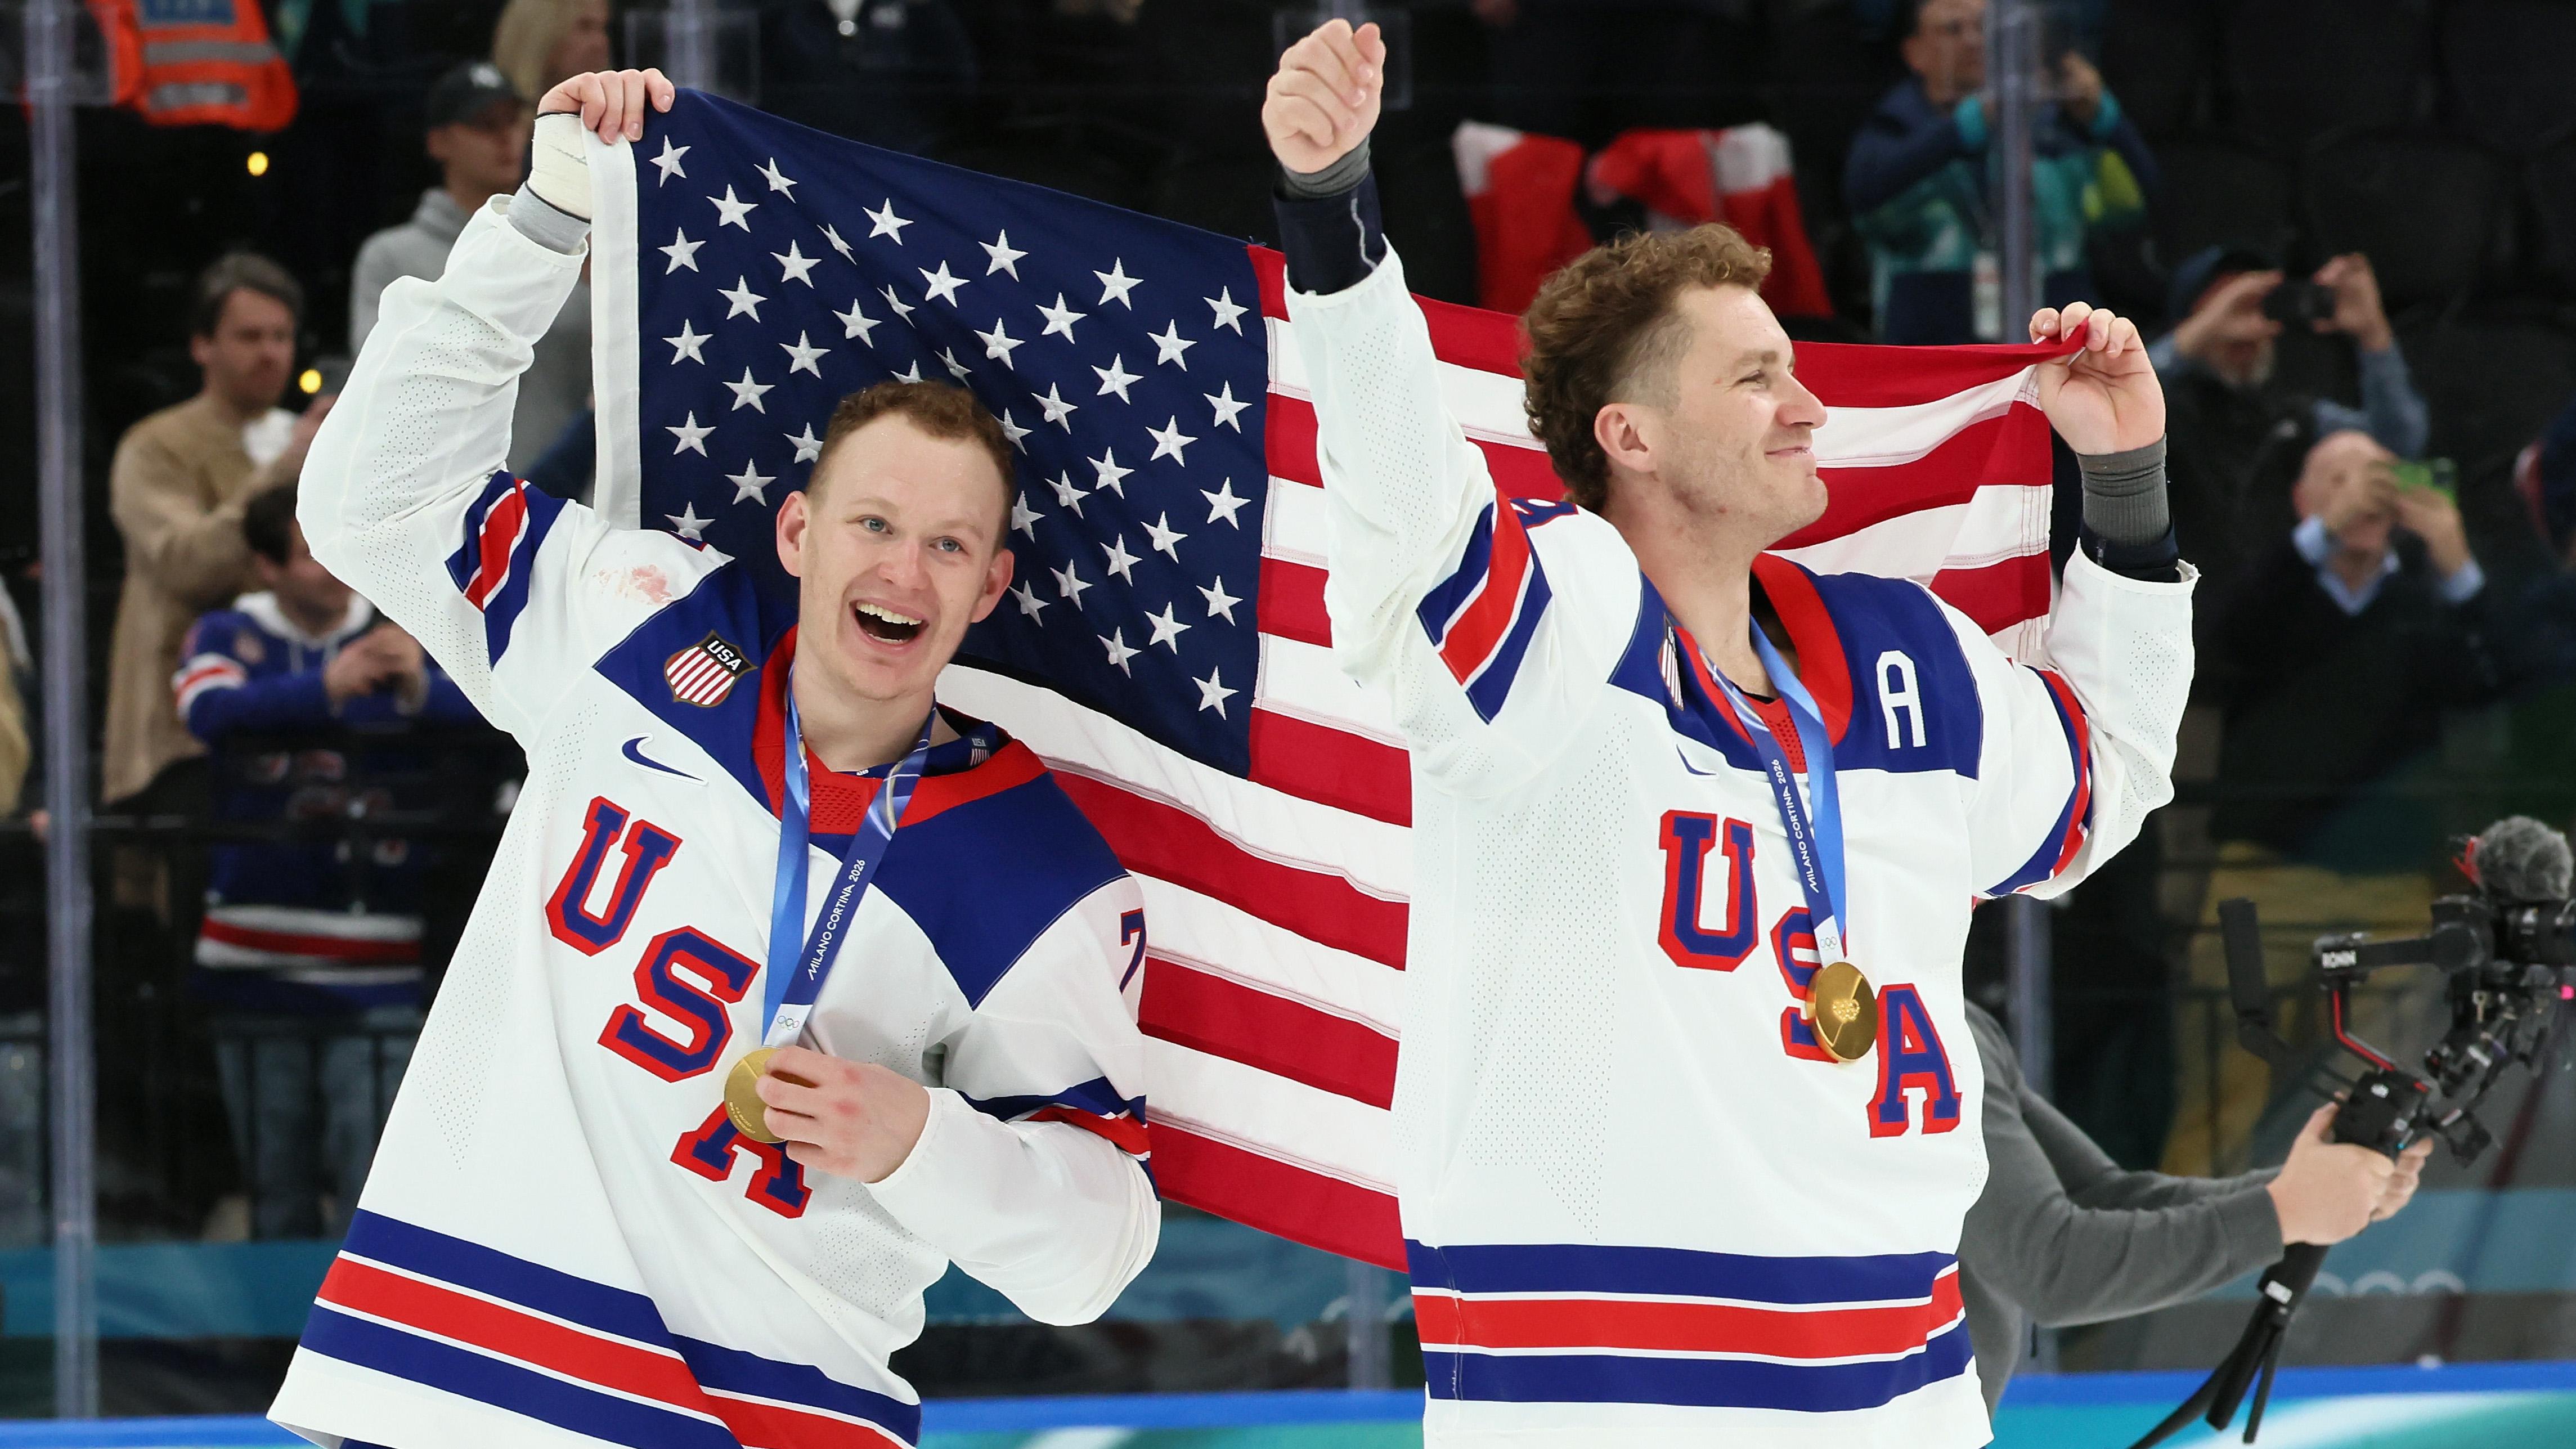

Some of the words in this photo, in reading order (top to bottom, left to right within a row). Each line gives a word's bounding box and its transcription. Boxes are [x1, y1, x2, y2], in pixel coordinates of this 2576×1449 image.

[707, 640, 742, 671] USA
[1876, 650, 1927, 750] A
[1771, 759, 1787, 784] 2026
[1783, 786, 1803, 839] CORTINA
[1798, 841, 1819, 893] MILANO
[807, 931, 833, 981] MILANO
[827, 884, 856, 930] CORTINA
[849, 859, 866, 882] 2026
[1119, 907, 1147, 995] 7
[545, 795, 813, 1219] USA
